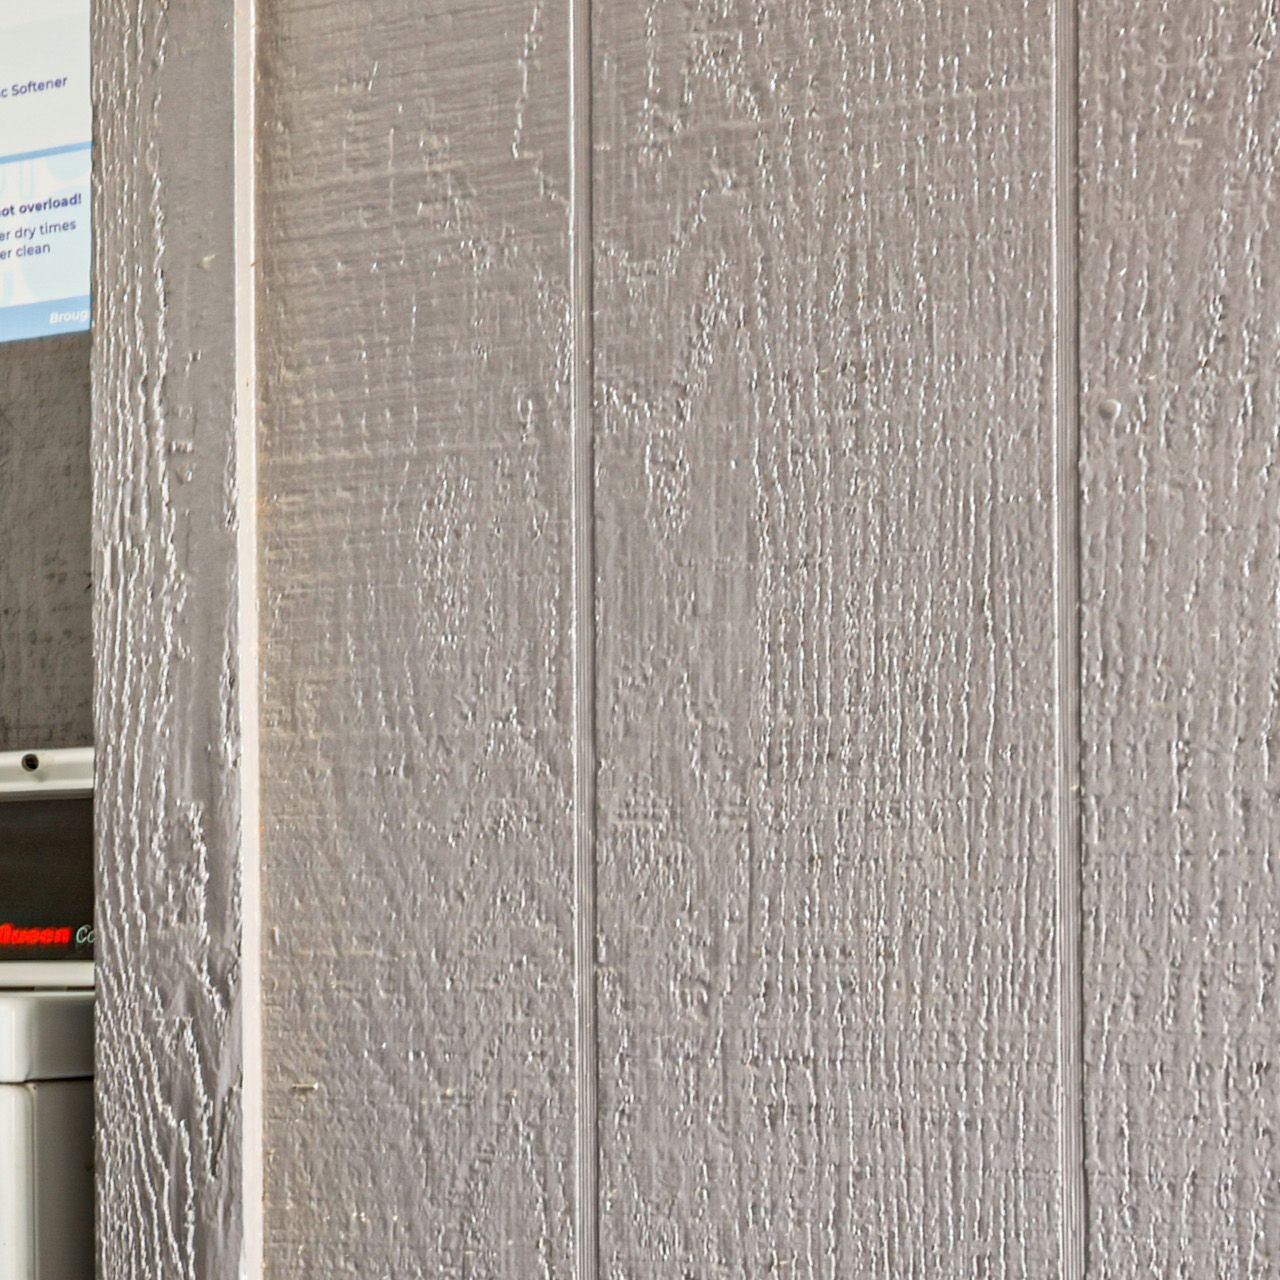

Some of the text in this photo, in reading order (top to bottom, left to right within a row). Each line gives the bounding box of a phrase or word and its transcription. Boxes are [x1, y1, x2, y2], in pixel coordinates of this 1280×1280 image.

[11, 77, 68, 96] Softener
[19, 193, 82, 214] overload!
[14, 227, 36, 240] dry
[40, 220, 77, 235] times
[15, 243, 51, 258] clean
